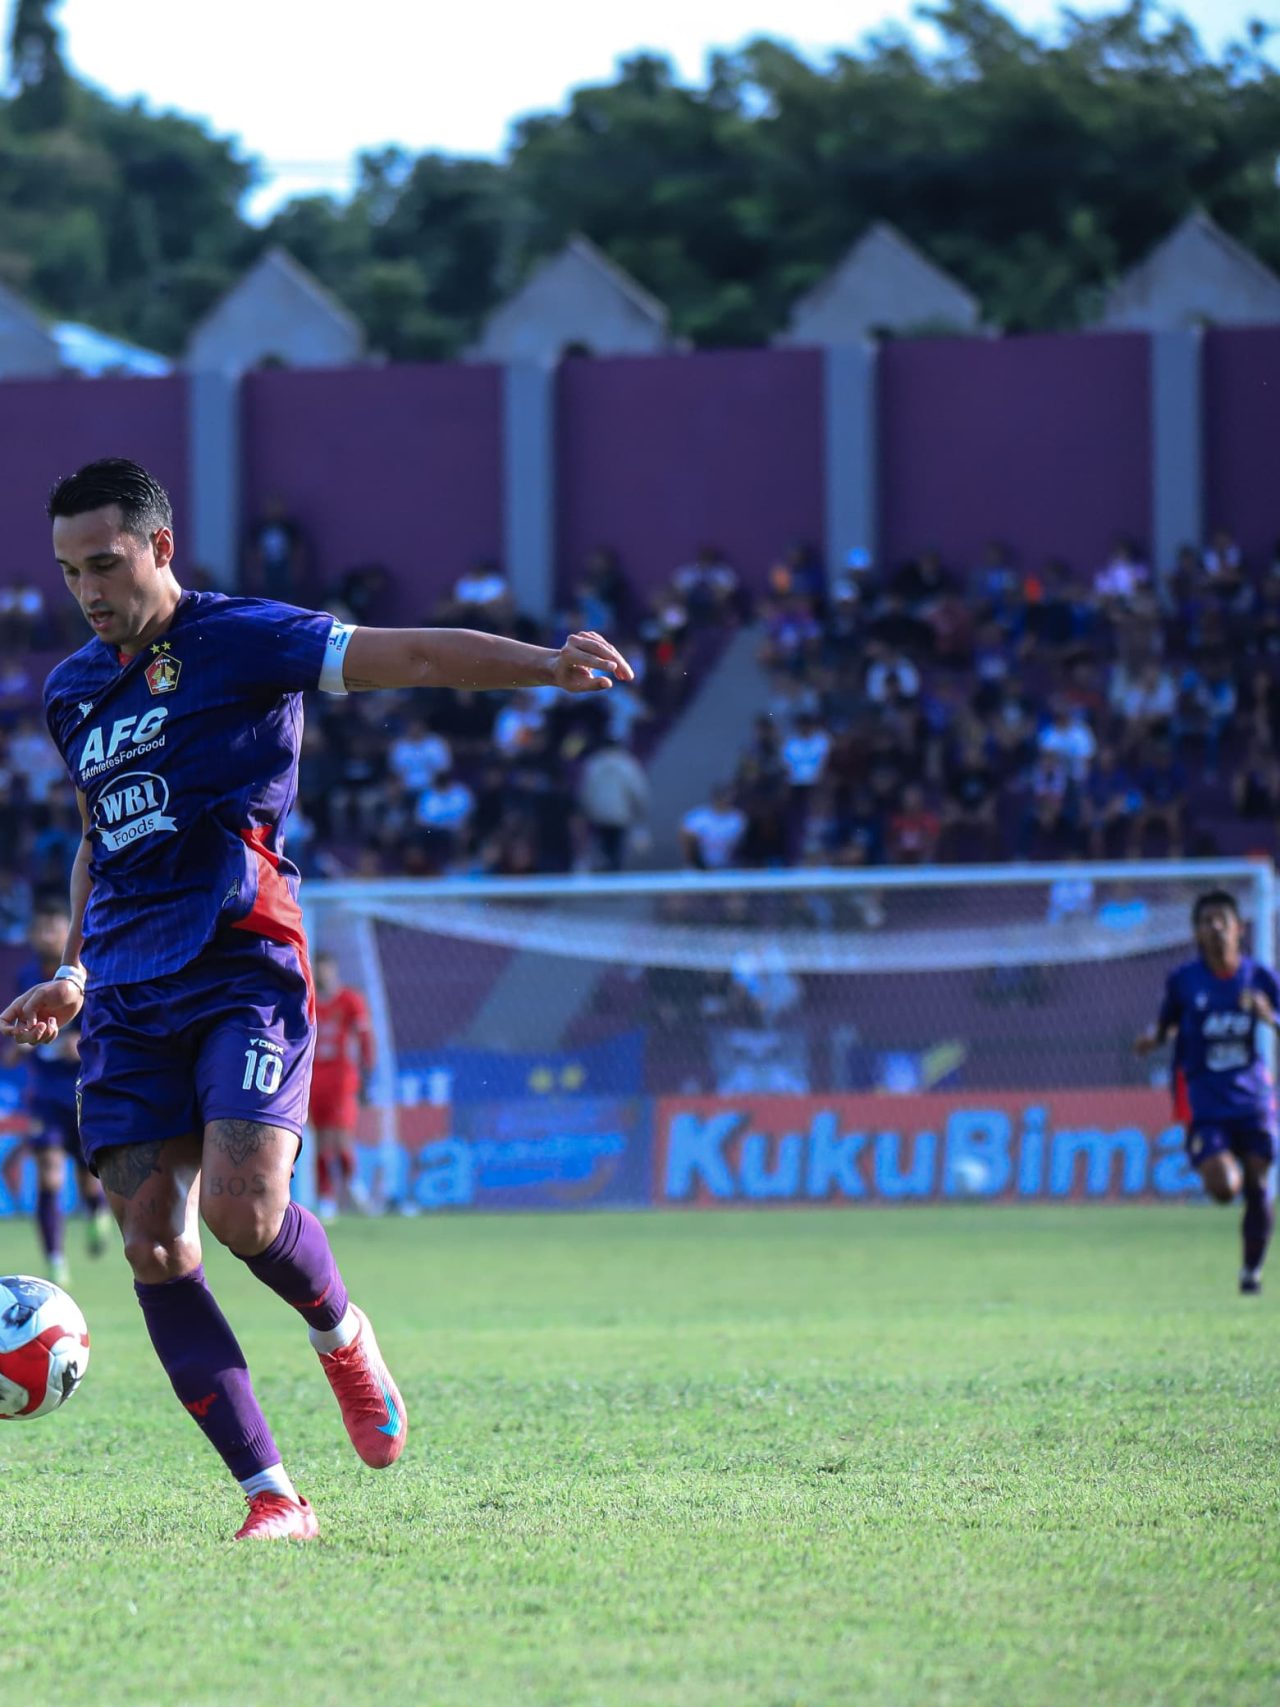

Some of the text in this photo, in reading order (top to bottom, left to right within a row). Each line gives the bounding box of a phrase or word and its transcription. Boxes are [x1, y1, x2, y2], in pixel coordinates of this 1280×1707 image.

[79, 707, 168, 771] AFG
[81, 734, 166, 782] #AthletesForGood
[98, 779, 159, 824] WBI
[113, 819, 155, 847] Foods
[242, 1049, 283, 1095] 10
